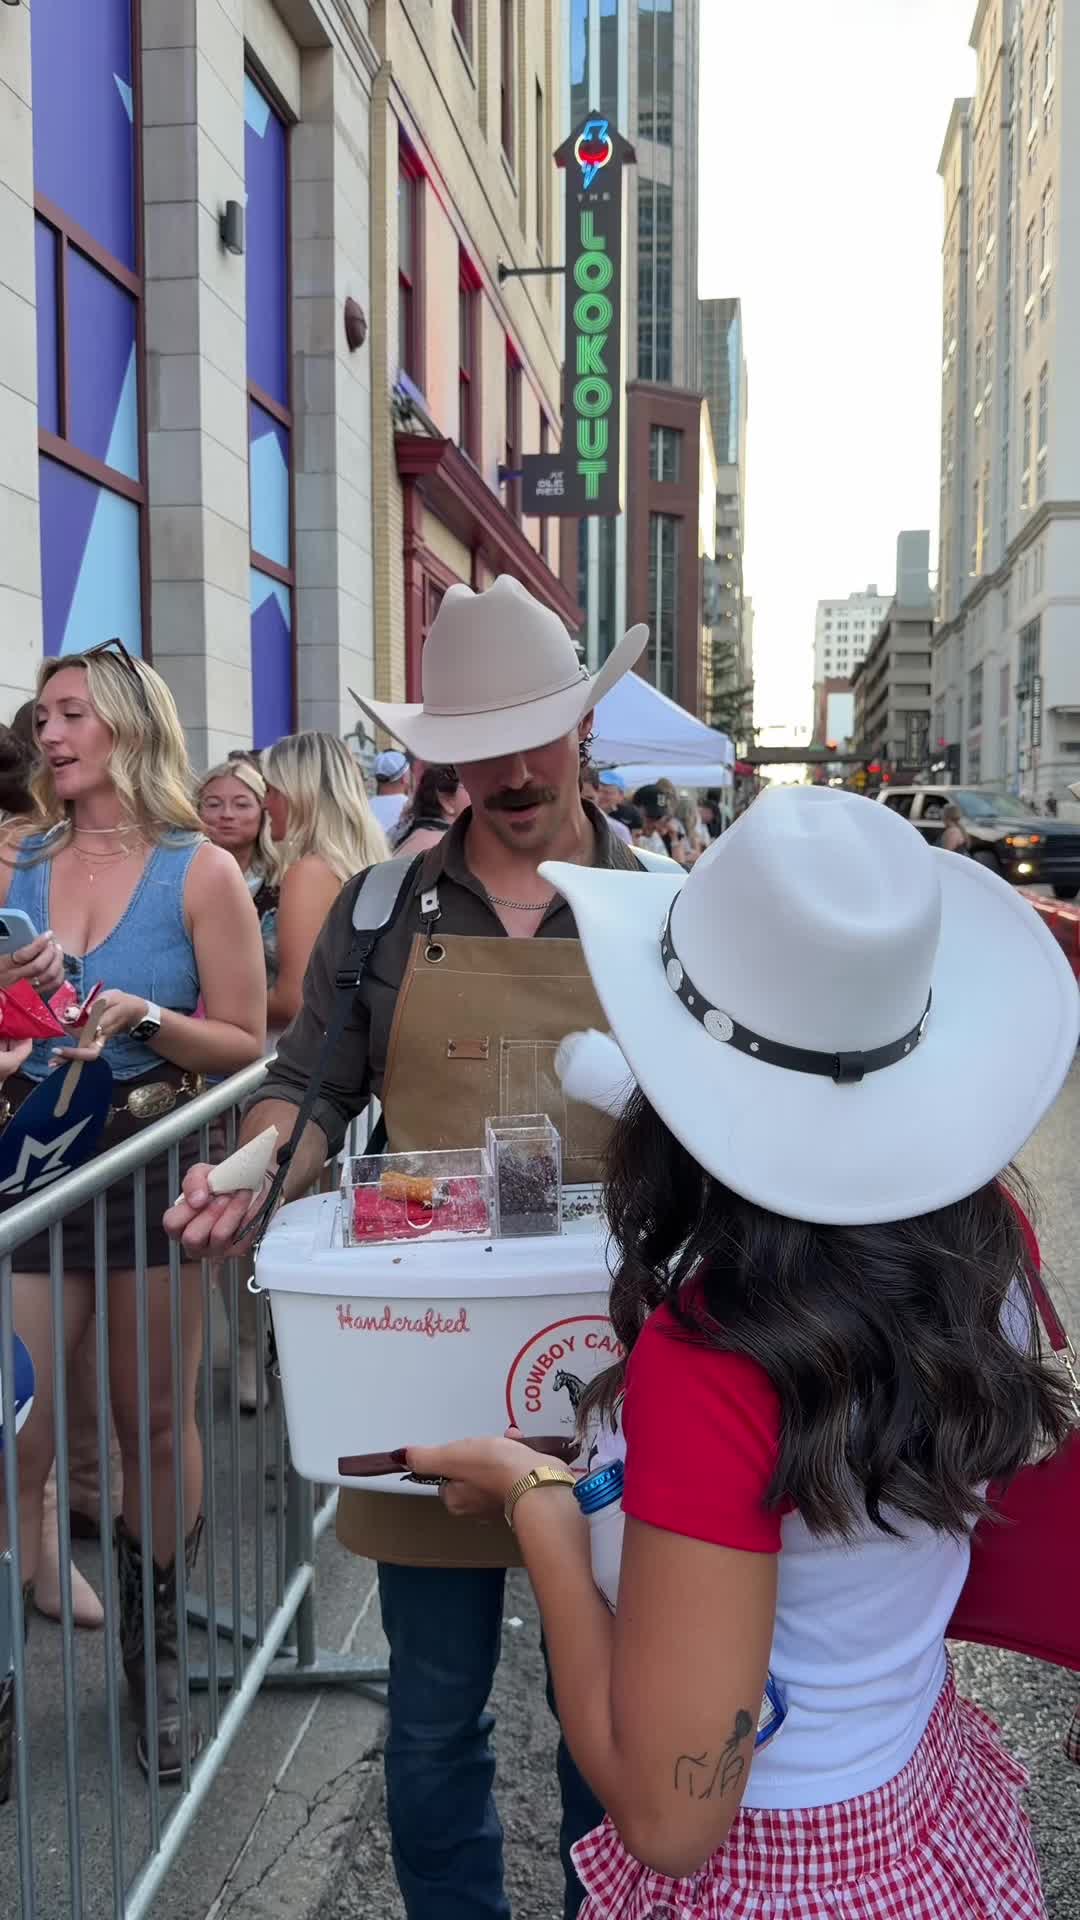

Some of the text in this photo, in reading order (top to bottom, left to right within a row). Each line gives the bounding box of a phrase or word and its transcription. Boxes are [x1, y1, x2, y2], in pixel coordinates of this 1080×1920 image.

[577, 192, 610, 202] THE
[573, 210, 613, 499] LOOKOUT
[535, 487, 565, 496] RED
[336, 1304, 470, 1337] Handcrafted
[524, 1335, 577, 1413] COWBOY
